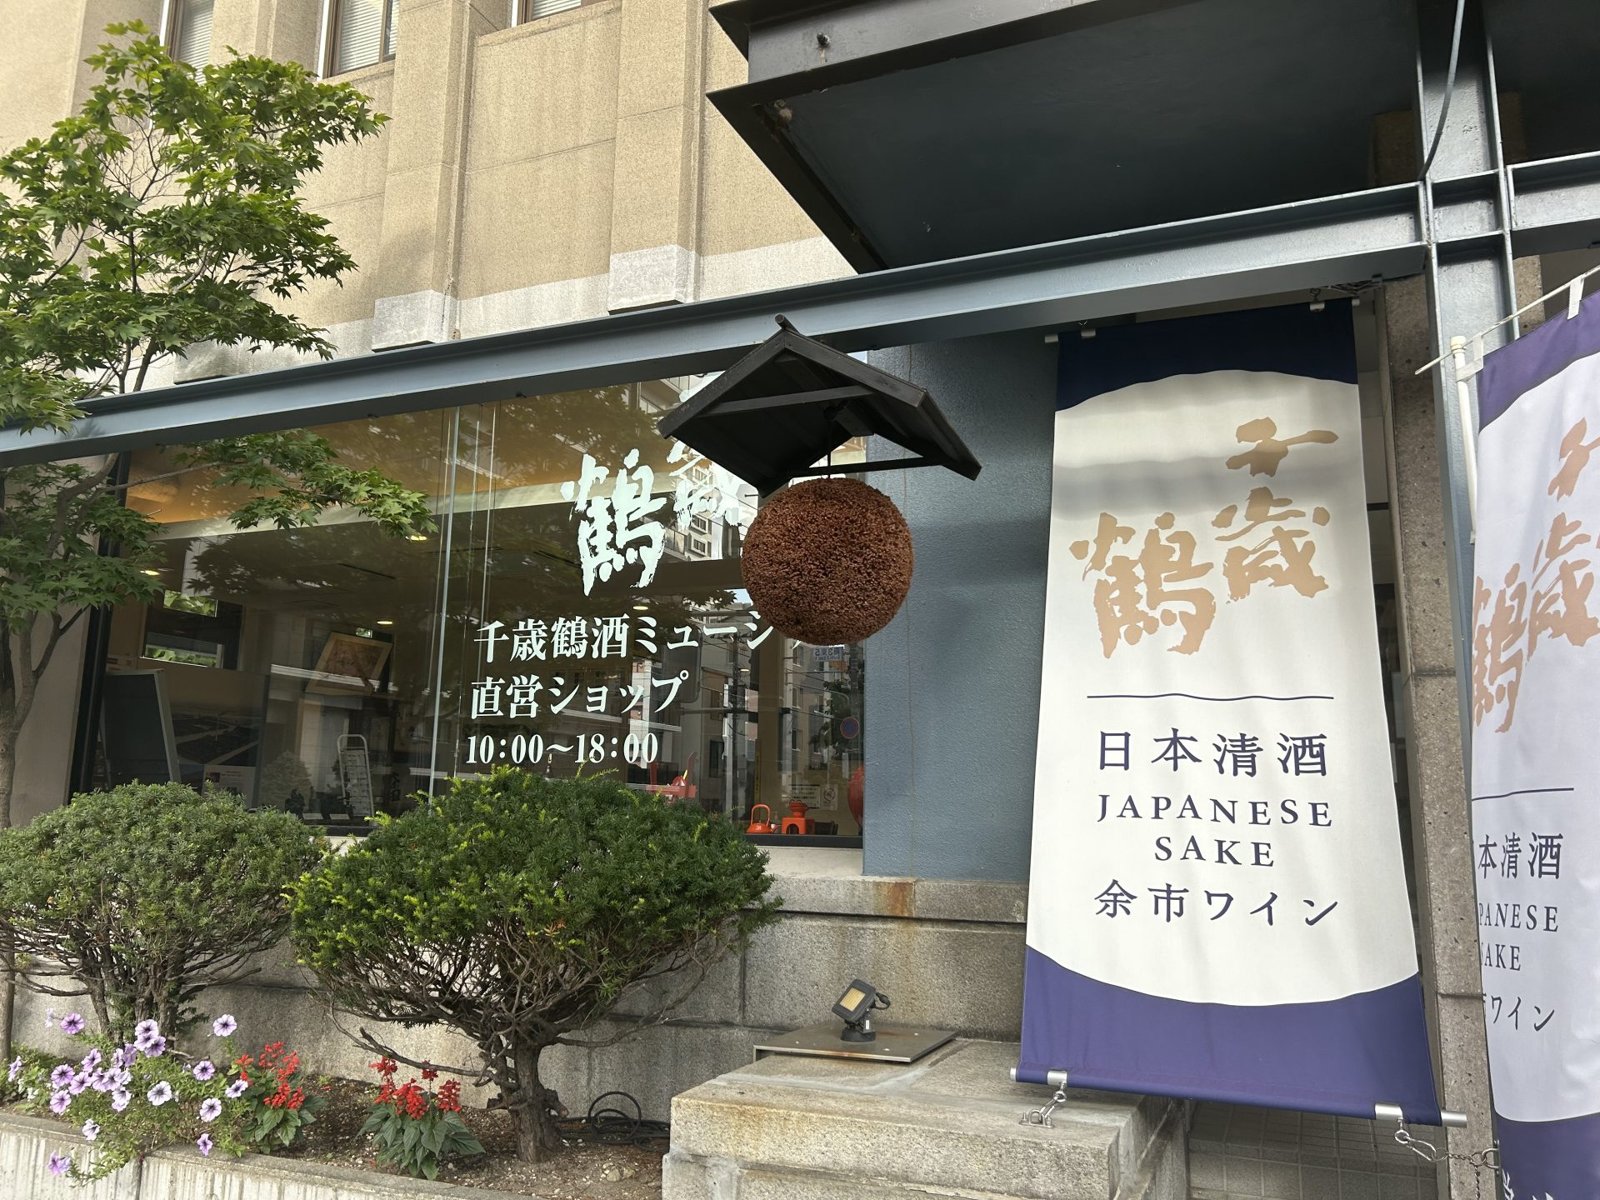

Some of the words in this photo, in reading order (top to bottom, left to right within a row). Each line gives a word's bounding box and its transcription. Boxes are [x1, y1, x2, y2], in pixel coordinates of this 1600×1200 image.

[471, 668, 689, 721] 直営ショップ
[1098, 727, 1328, 778] 日本清酒
[1097, 794, 1333, 828] JAPANESE
[1154, 836, 1275, 867] SAKE
[1094, 879, 1339, 926] 余市ワイン
[1481, 942, 1522, 972] AKE
